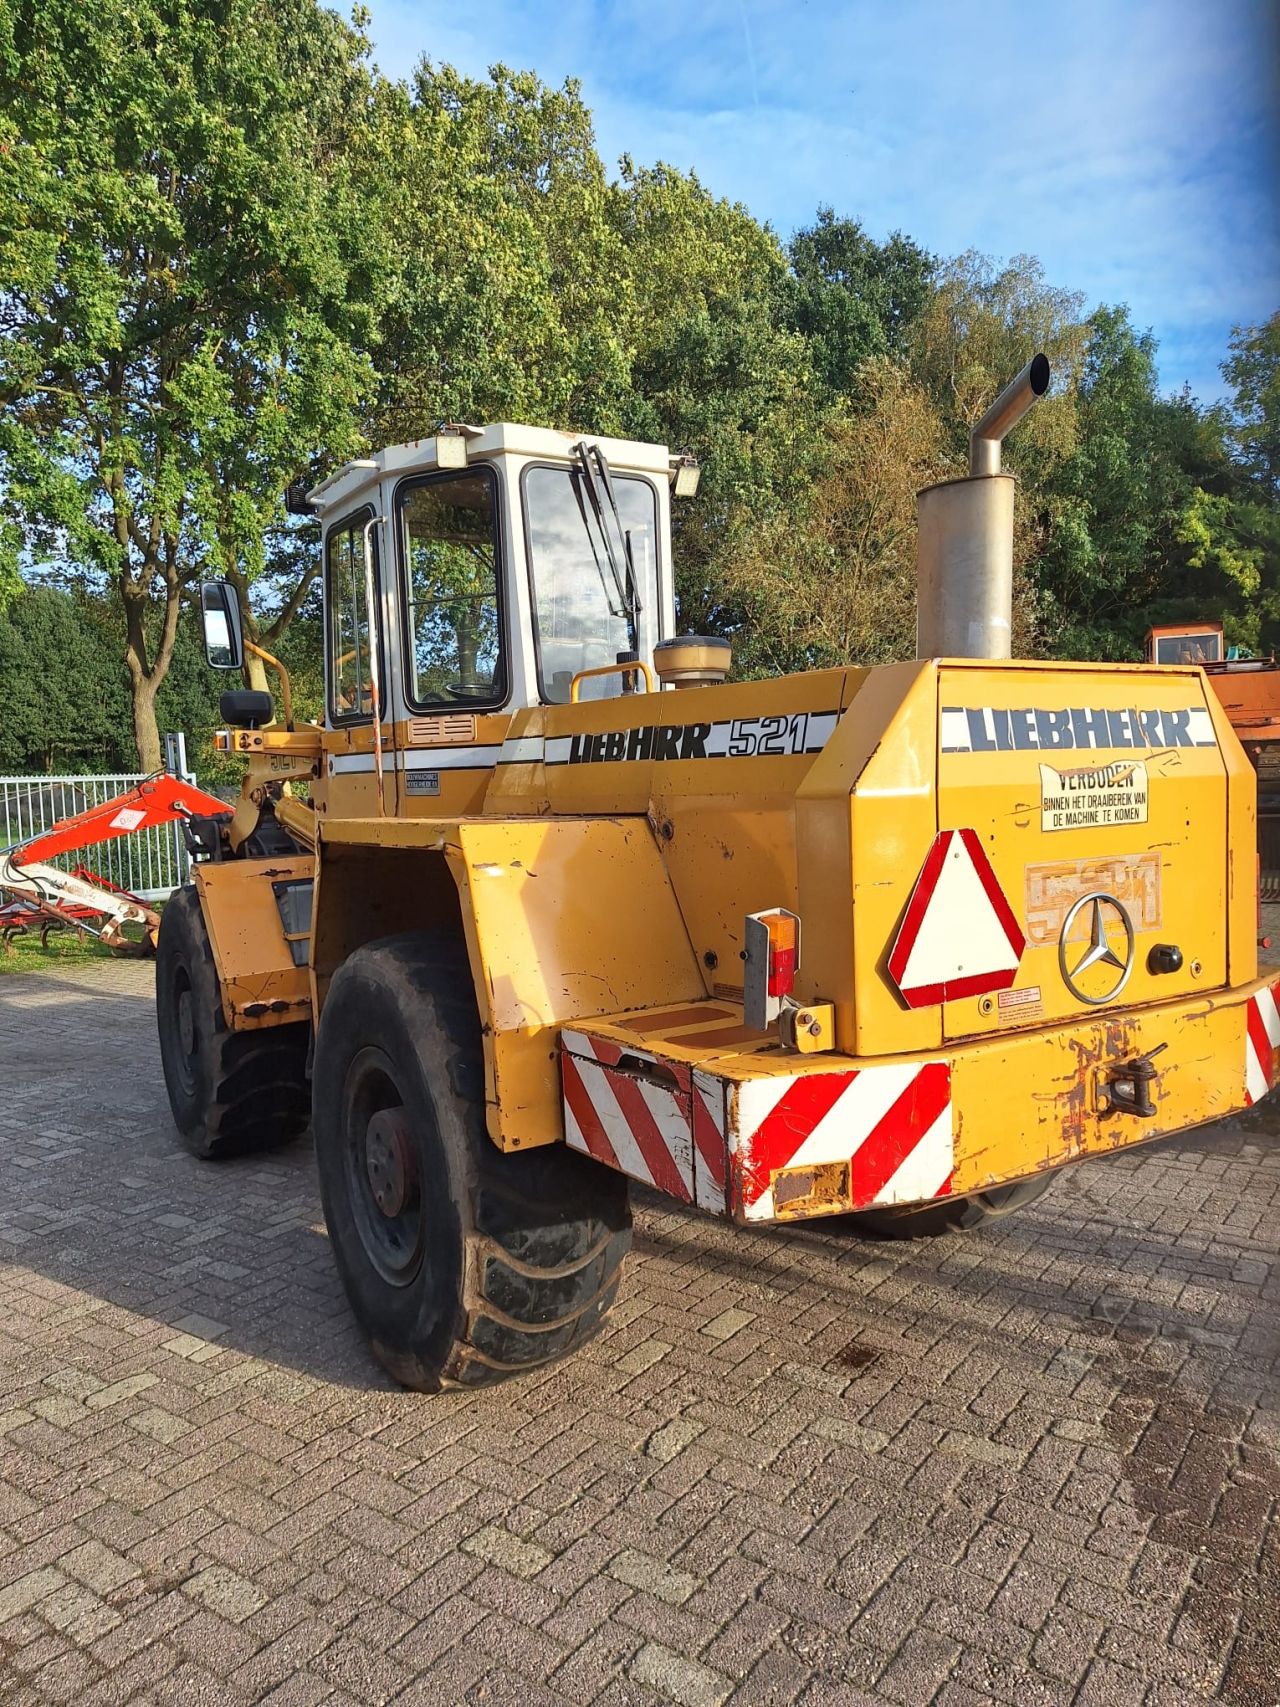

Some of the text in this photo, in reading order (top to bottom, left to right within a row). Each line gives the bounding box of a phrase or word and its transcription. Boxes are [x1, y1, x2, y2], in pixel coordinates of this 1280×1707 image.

[569, 713, 809, 764] LIEBHRR 521
[965, 708, 1194, 752] LIEBHERR
[1059, 764, 1134, 791] VERBODEN
[1044, 792, 1146, 811] BINNEN HET DRAAIBEREIK VAN
[1053, 807, 1140, 827] DE MACHINE TE KOMEN
